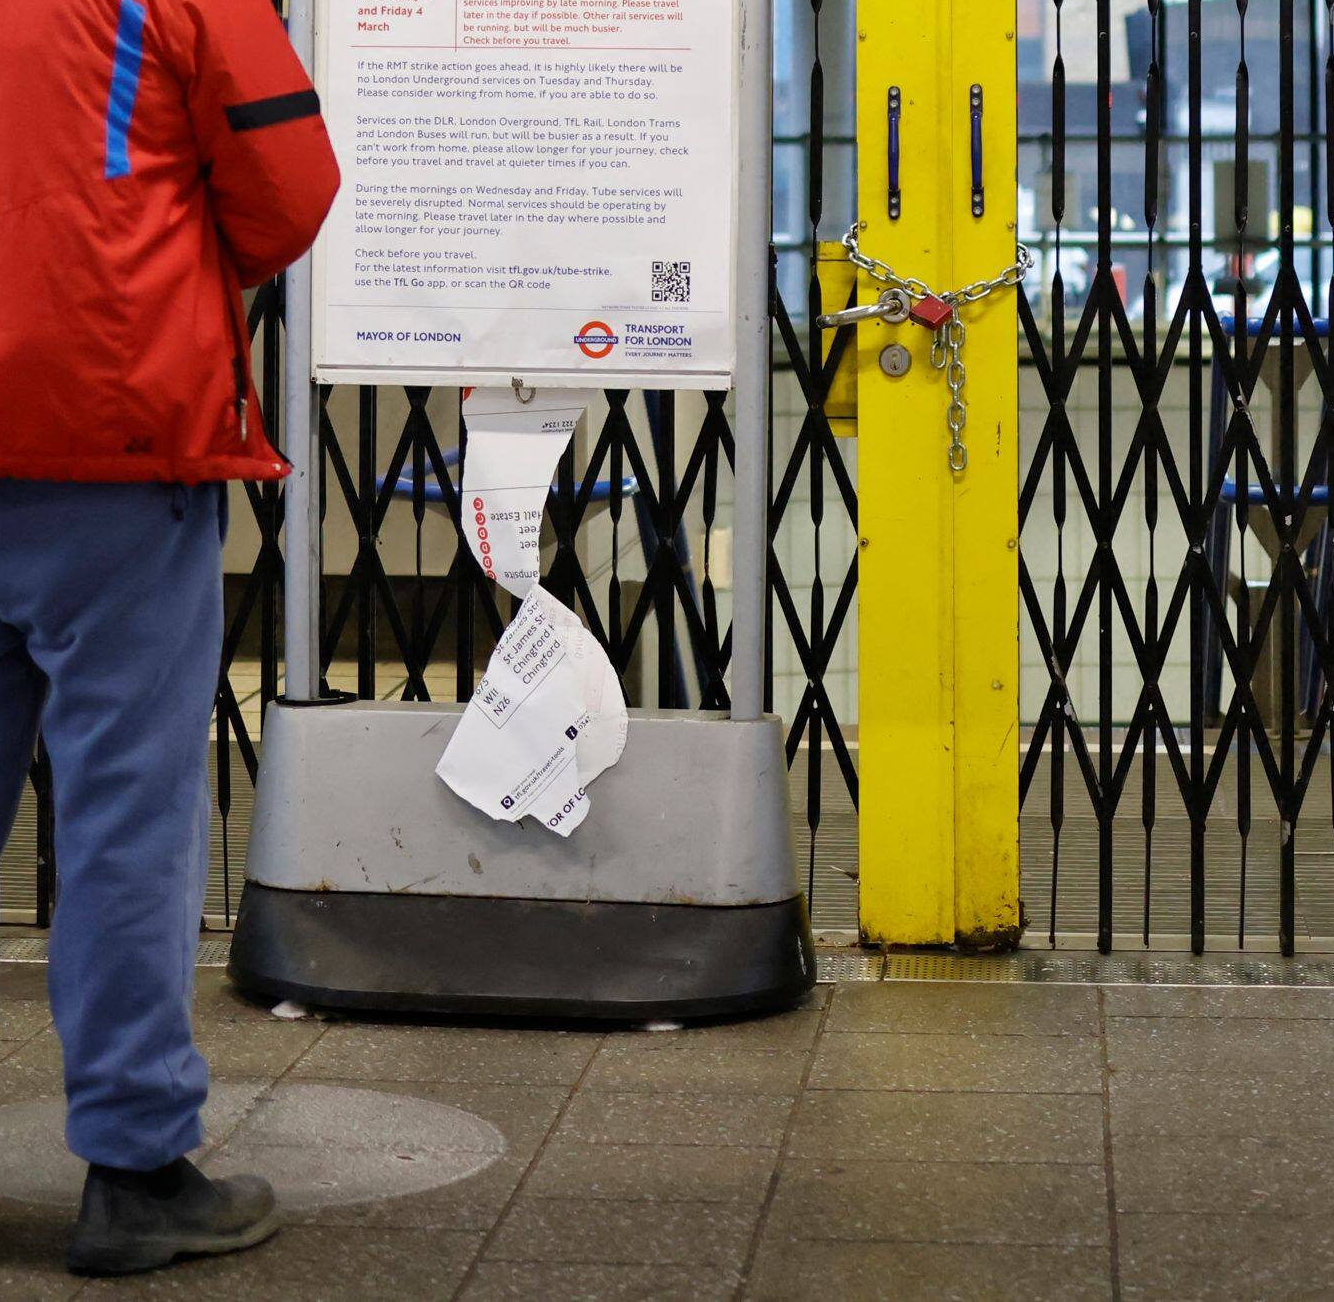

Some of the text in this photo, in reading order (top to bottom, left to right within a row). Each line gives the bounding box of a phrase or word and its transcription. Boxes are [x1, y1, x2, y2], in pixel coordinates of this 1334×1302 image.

[357, 5, 422, 17] and Friday 4
[357, 21, 389, 31] March
[354, 248, 476, 260] Check before you travel.
[355, 262, 611, 277] For the latest information visit tfl.gov.uk/tube-strike.
[374, 277, 390, 286] the
[394, 277, 408, 286] TfL
[411, 278, 424, 287] Go
[427, 280, 447, 289] app,
[489, 279, 505, 288] the
[508, 279, 524, 288] QR
[526, 280, 550, 289] code
[625, 324, 684, 334] TRANSPORT
[356, 331, 460, 342] MAYOR OF LONDON
[575, 336, 617, 344] UNDERGROUND
[625, 336, 691, 346] FOR LONDON
[490, 512, 520, 521] Estate
[504, 570, 539, 579] ampsite
[503, 653, 514, 665] St
[513, 625, 538, 655] James
[513, 629, 551, 675] Chingford
[522, 639, 562, 685] Chingford
[493, 697, 512, 717] N26
[514, 746, 565, 801] tfl.gov.uk/travel-tools
[563, 797, 579, 815] OF
